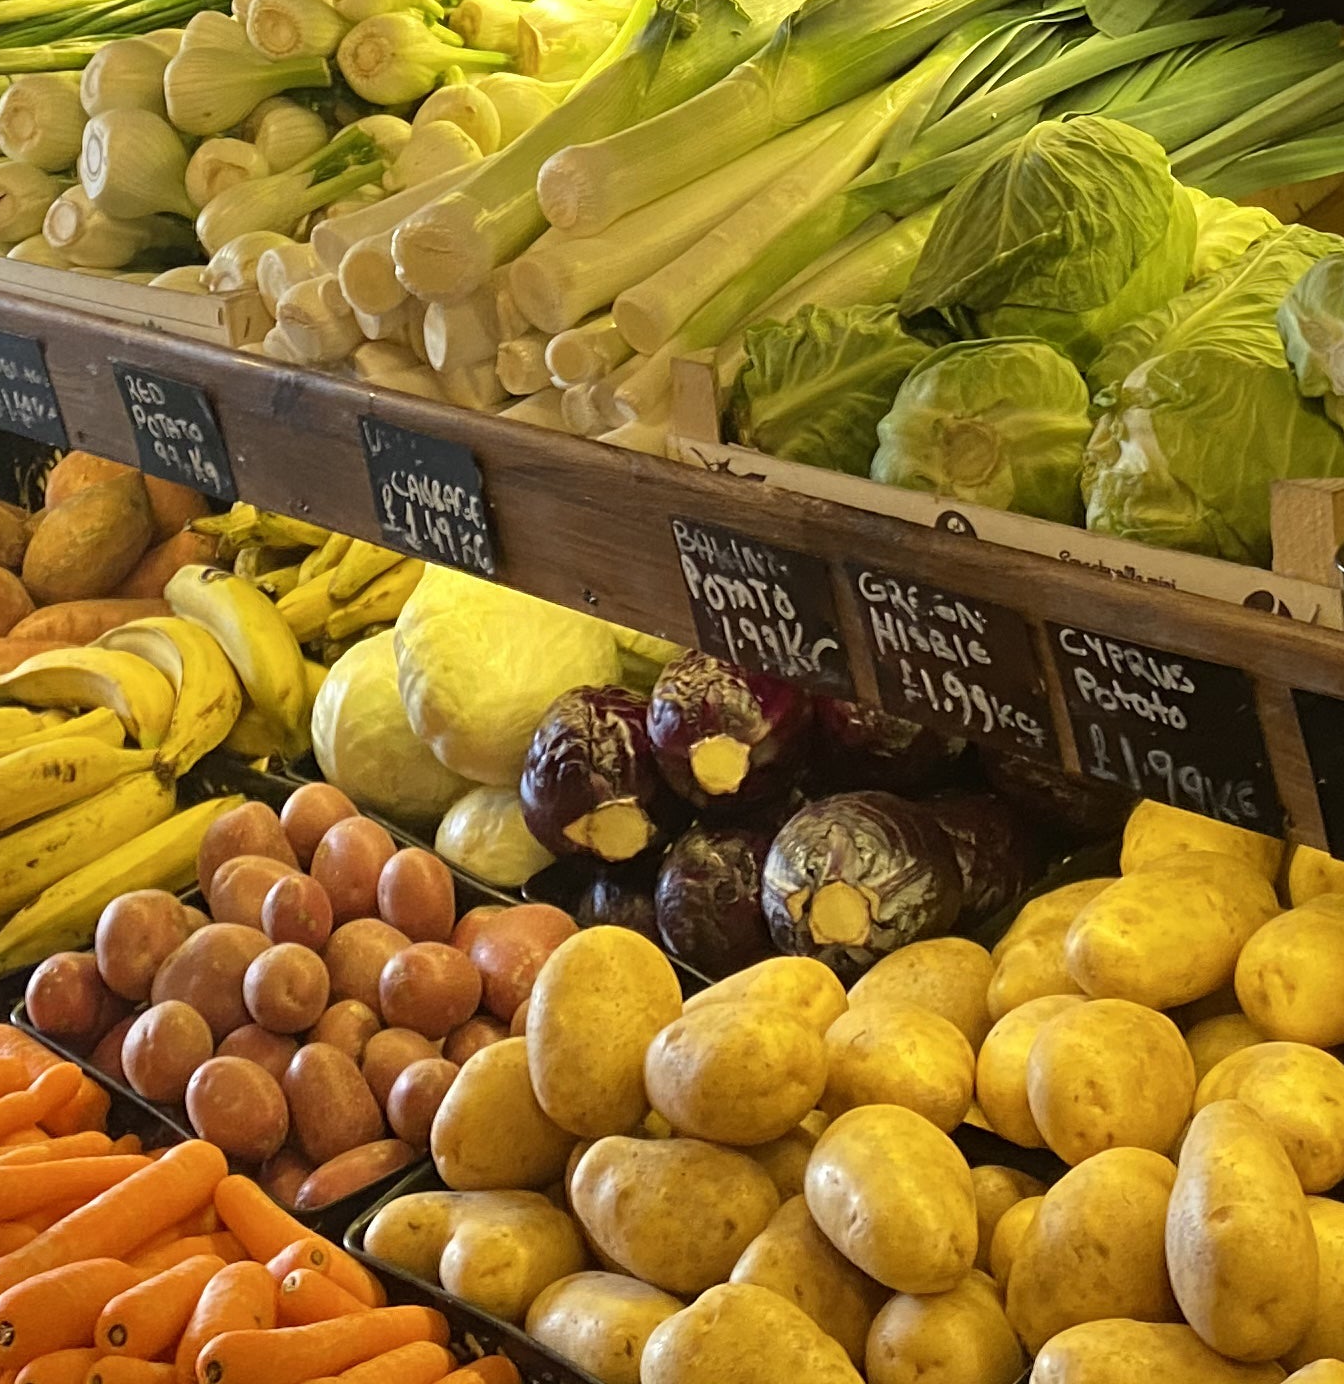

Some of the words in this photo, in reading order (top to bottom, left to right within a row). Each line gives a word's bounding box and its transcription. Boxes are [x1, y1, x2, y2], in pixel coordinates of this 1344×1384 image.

[125, 374, 166, 406] RED
[131, 404, 204, 445] POTATO
[1059, 628, 1196, 695] CYPRUS
